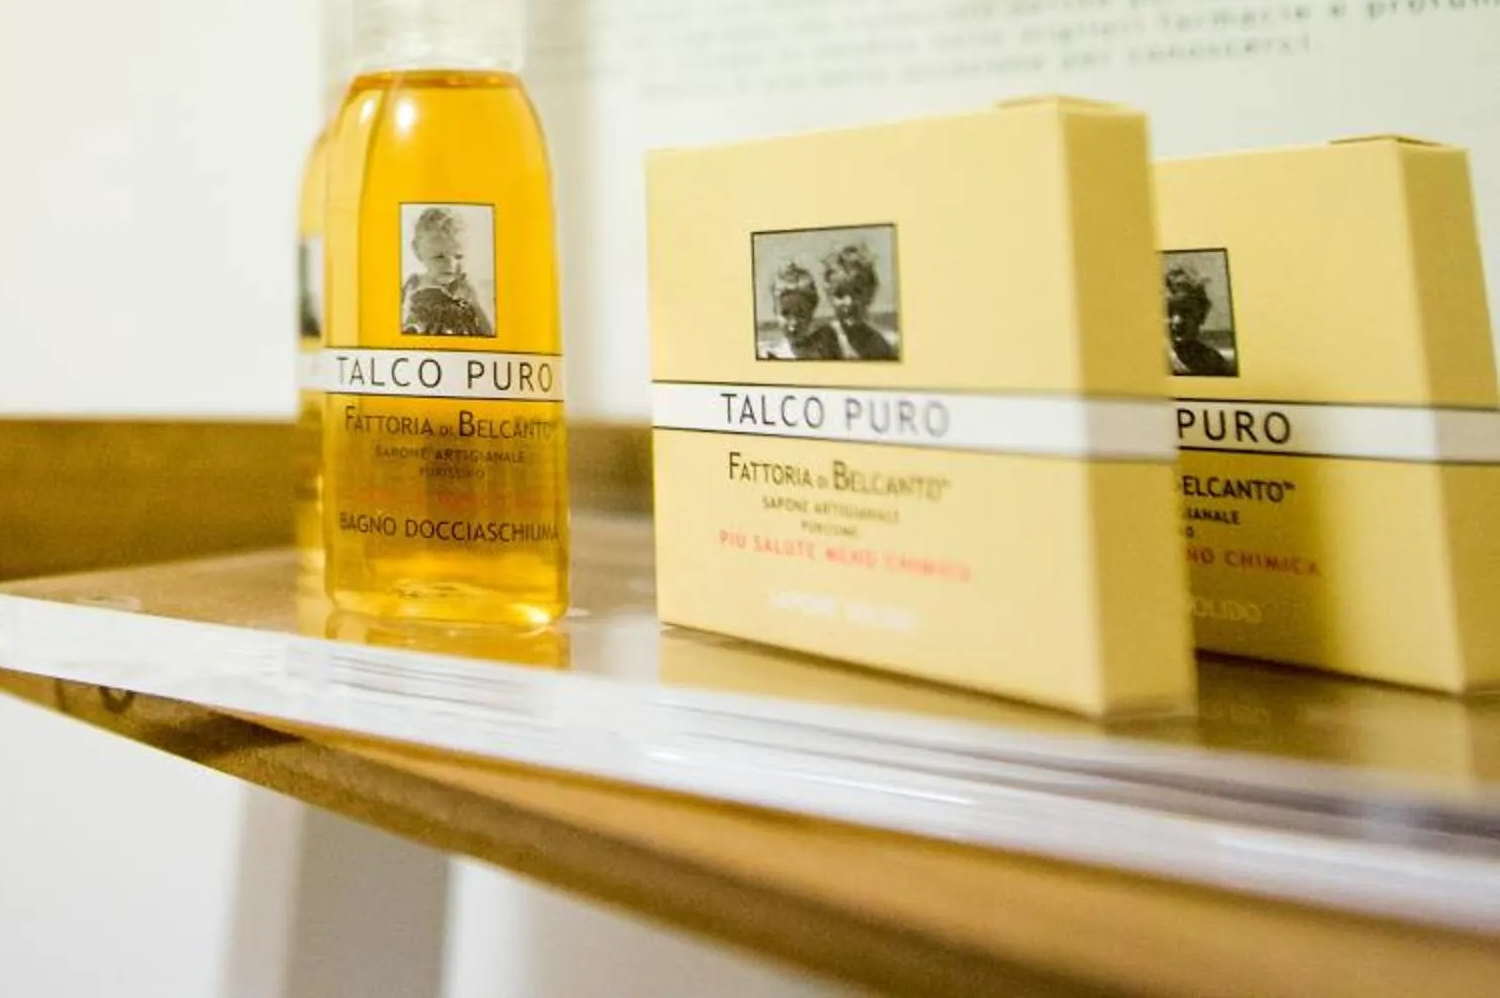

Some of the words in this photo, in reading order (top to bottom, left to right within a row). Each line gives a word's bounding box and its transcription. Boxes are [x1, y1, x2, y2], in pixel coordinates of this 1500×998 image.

[336, 357, 442, 388] TALCO
[467, 360, 552, 392] PURO
[344, 406, 433, 435] FATTORIA
[720, 393, 825, 429] TALCO
[845, 398, 951, 438] PURO
[1176, 409, 1291, 444] PURO
[729, 452, 812, 488] FATTORIA
[1181, 475, 1286, 503] ELCANTO
[339, 512, 397, 537] BAGNO
[753, 535, 817, 561] SALUTE
[1225, 550, 1321, 577] CHIMICA
